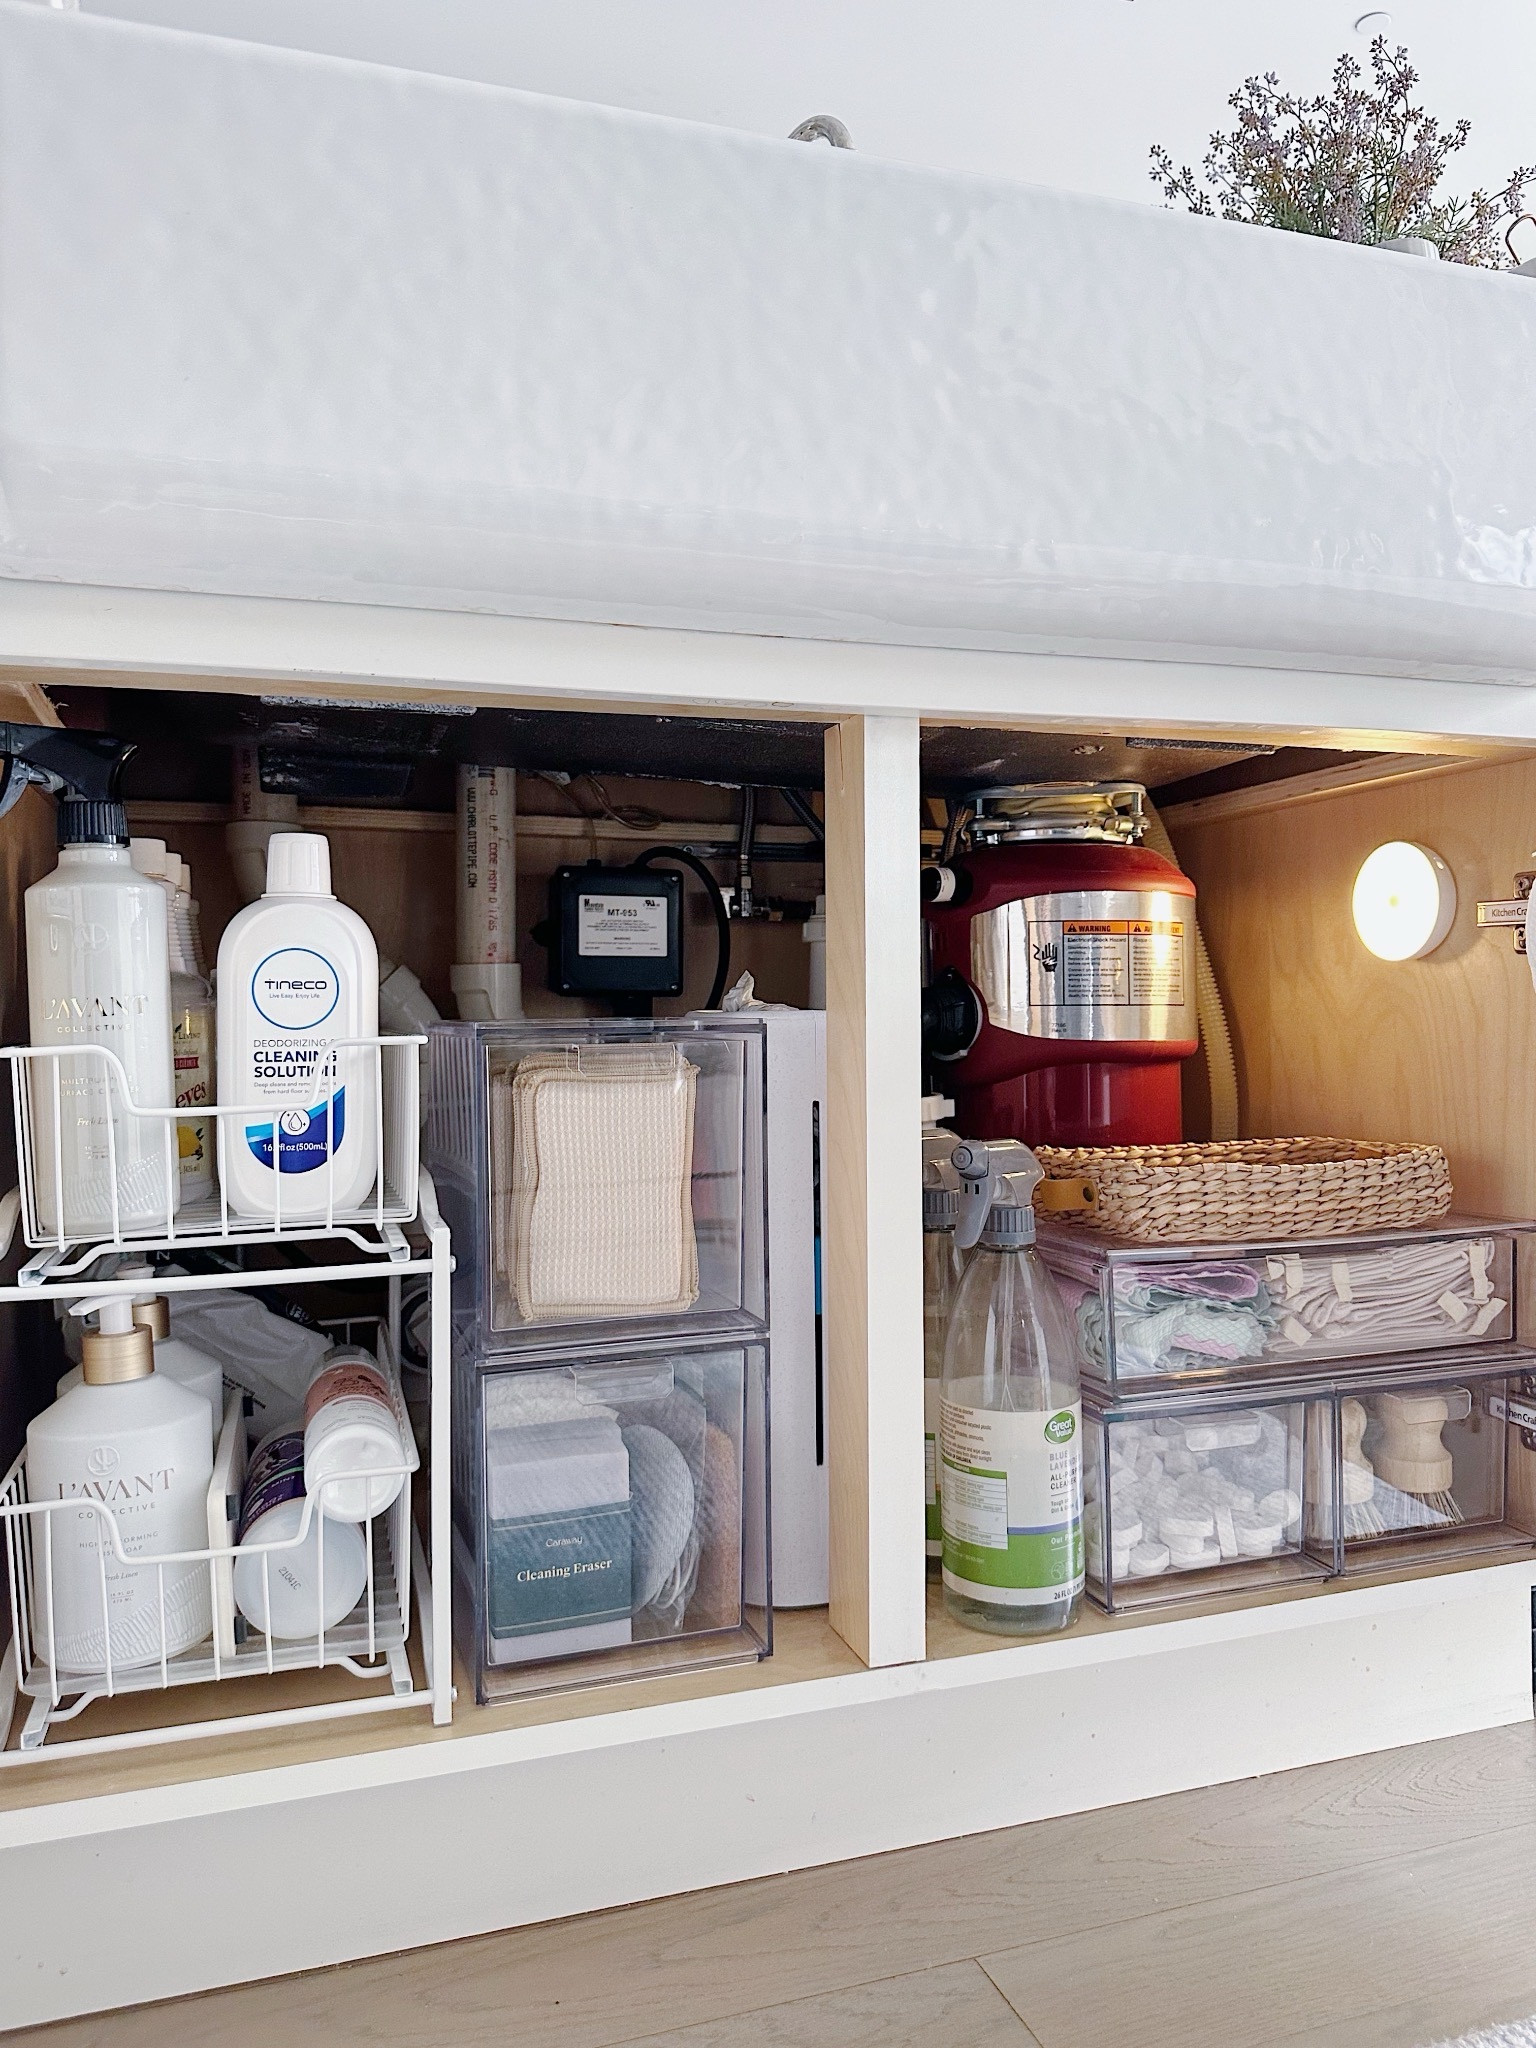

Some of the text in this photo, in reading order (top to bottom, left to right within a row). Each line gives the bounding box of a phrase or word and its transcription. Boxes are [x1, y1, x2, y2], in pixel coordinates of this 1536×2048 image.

[253, 1038, 327, 1048] DEODORIZING
[254, 1065, 337, 1078] SOLUTIN
[1049, 1417, 1073, 1432] Great
[1049, 1450, 1069, 1461] BLUE
[58, 1468, 176, 1502] L'AVANT
[78, 1502, 157, 1519] COECTIVE
[103, 1531, 159, 1546] PEORMING
[545, 1536, 583, 1548] Caraway
[517, 1559, 613, 1582] Cleaning Eraser
